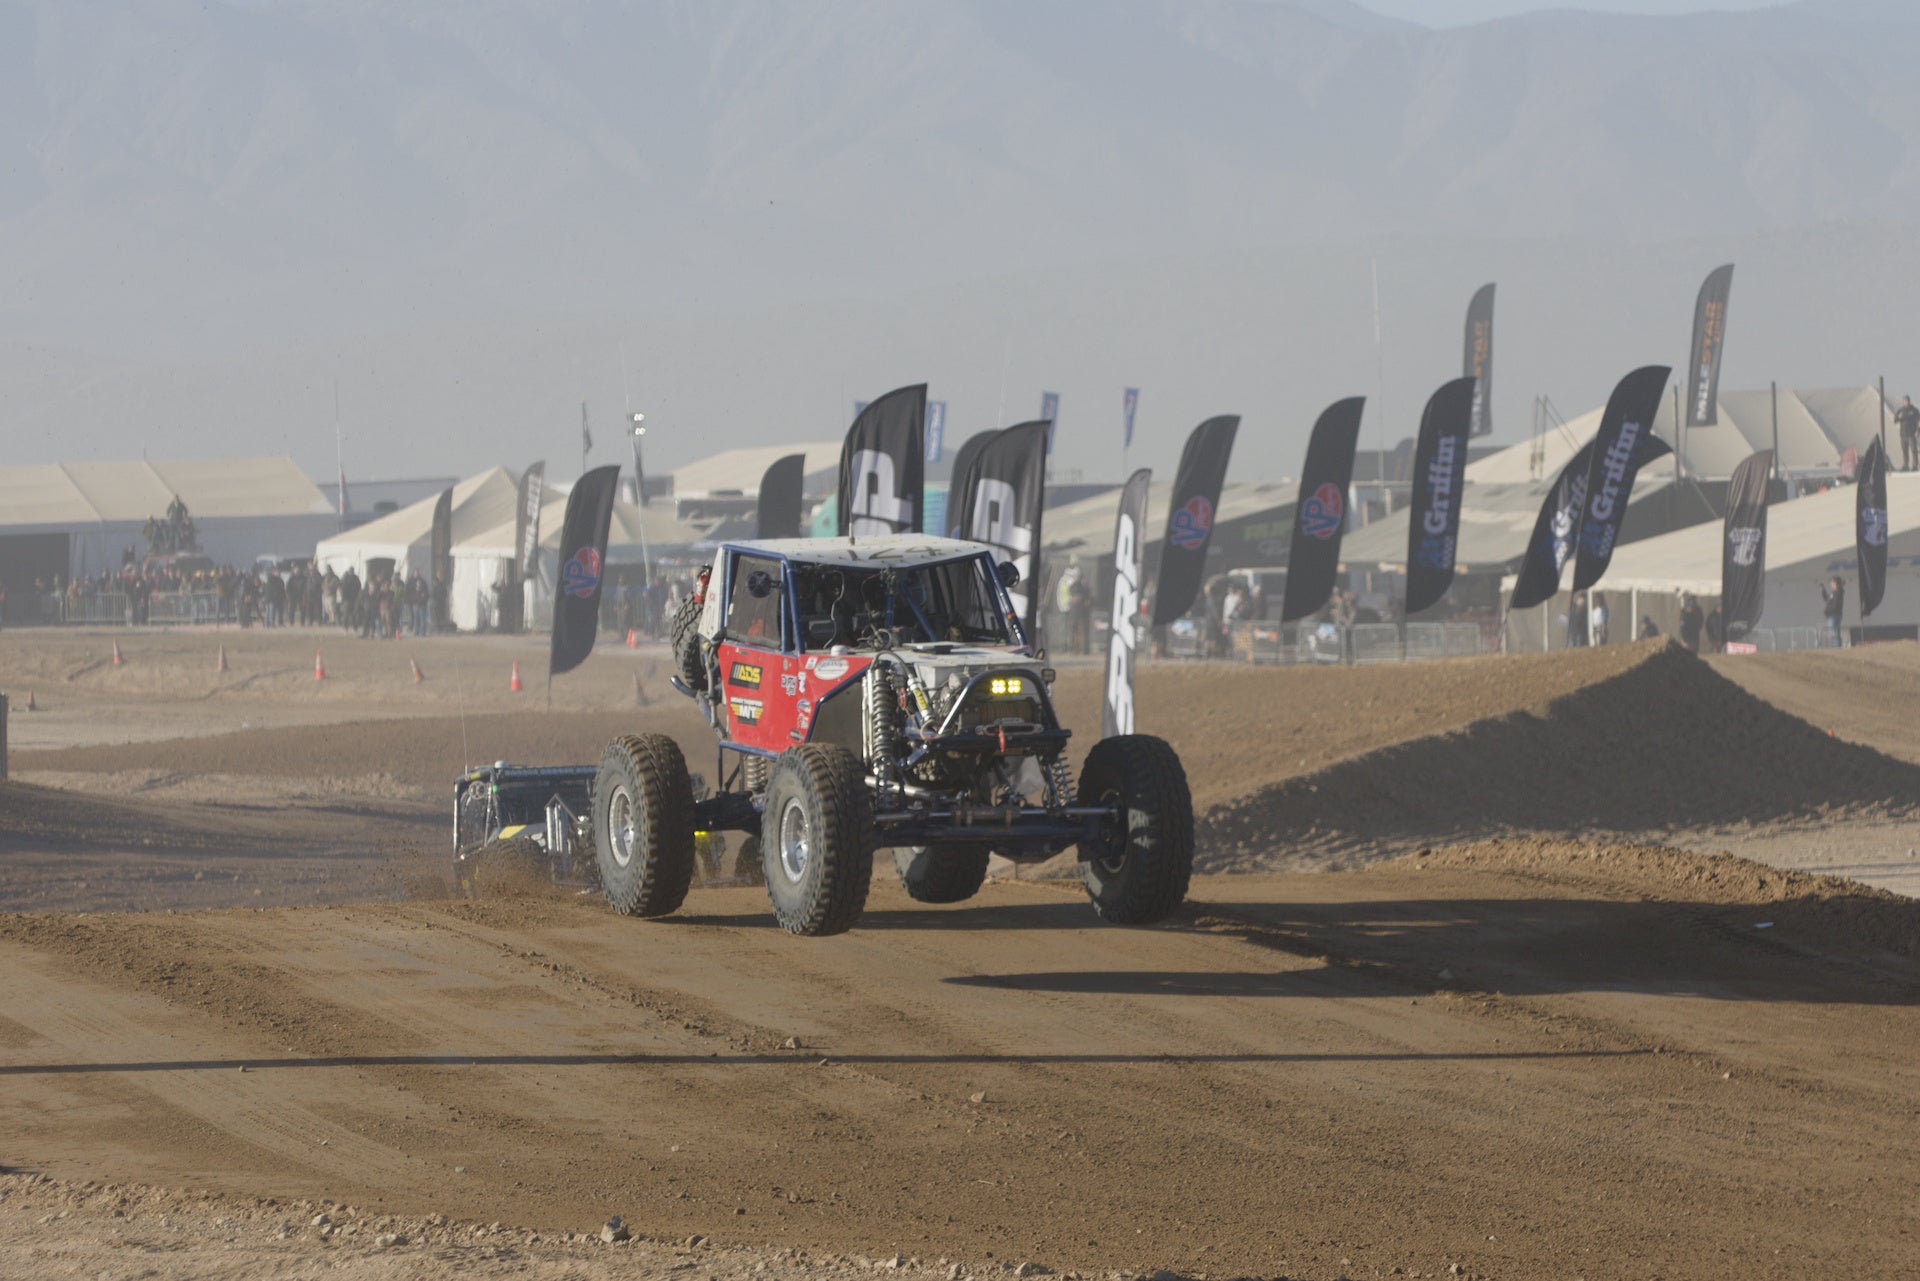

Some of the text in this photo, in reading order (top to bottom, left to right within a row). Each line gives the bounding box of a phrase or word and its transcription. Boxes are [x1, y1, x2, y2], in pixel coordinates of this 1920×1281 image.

[1423, 435, 1456, 534] Griffin
[1591, 421, 1639, 521] Griffin
[1172, 508, 1208, 545] VP
[1303, 496, 1339, 535] VP
[563, 559, 598, 595] VP
[738, 664, 761, 683] ADS
